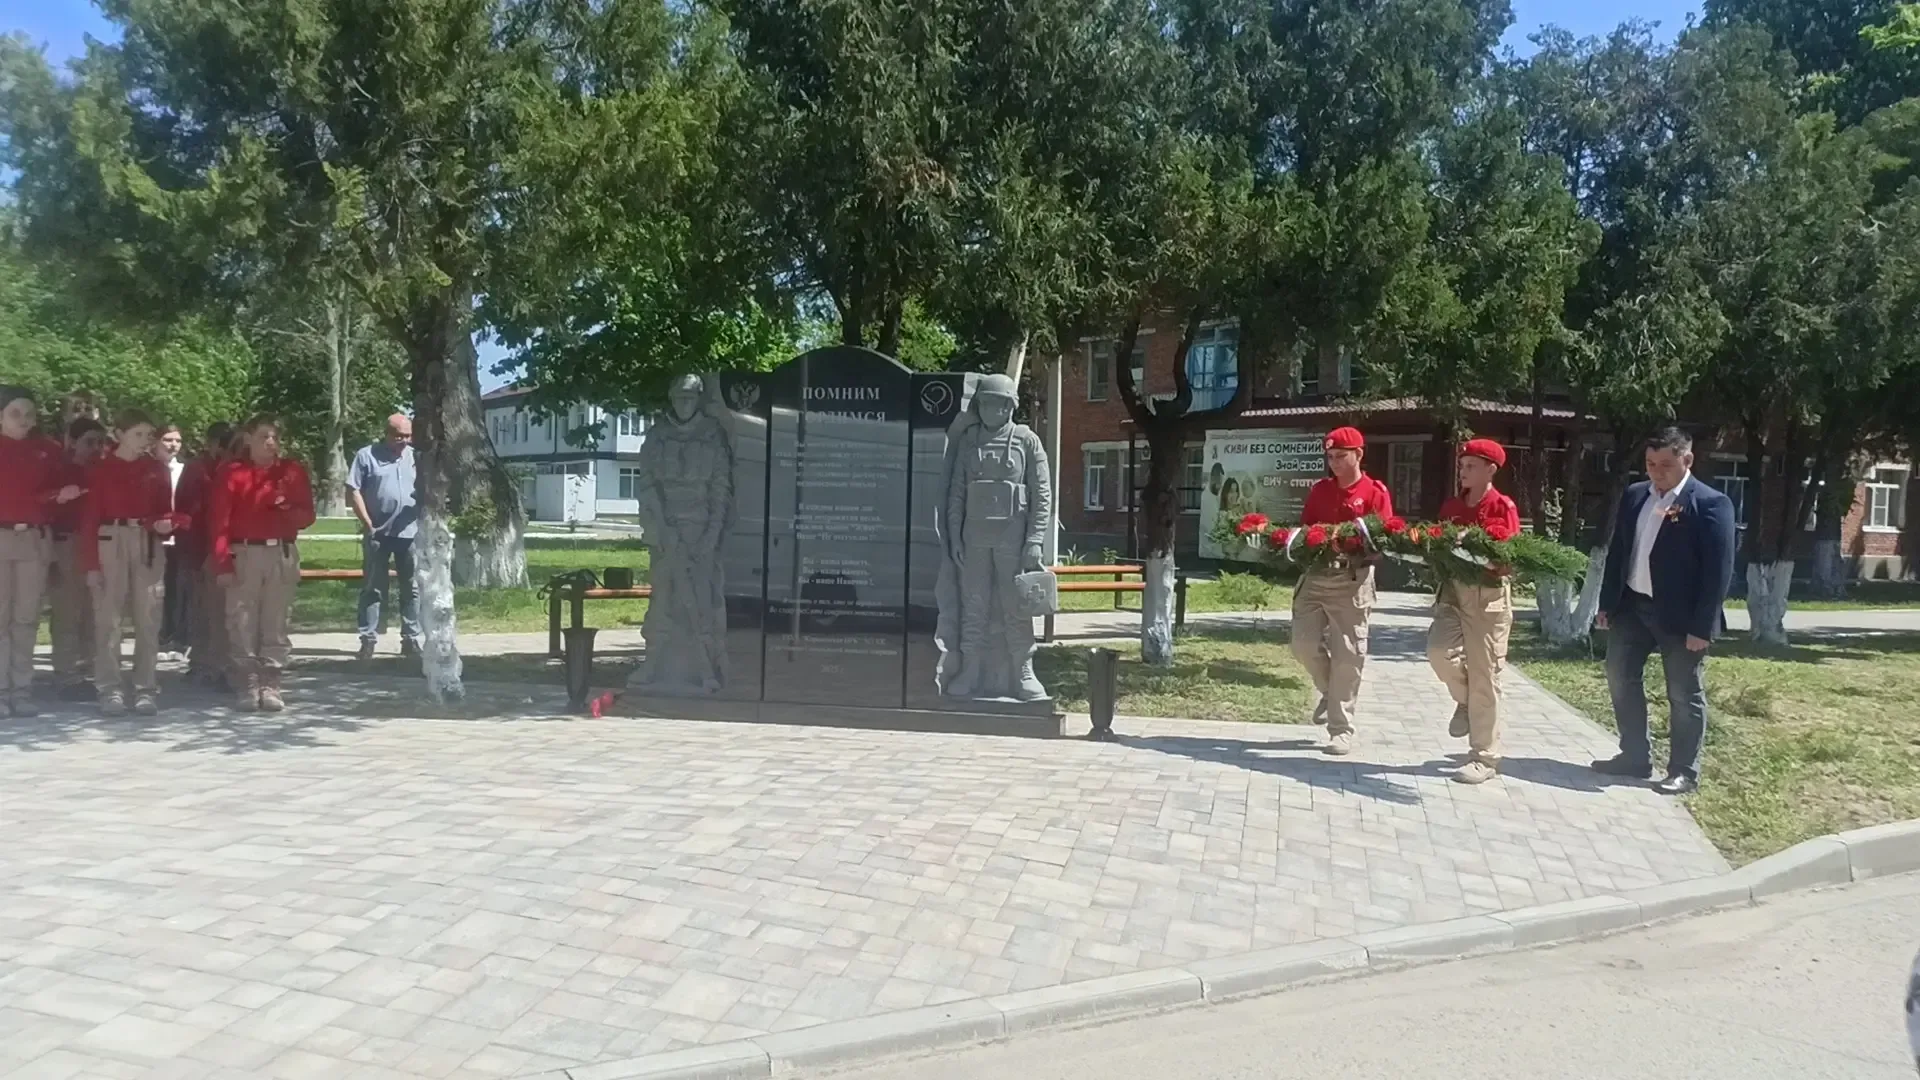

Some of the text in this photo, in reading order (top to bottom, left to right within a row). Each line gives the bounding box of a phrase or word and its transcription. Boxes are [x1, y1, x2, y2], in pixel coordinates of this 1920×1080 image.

[802, 386, 880, 400] ПОМНИМ
[1250, 443, 1266, 454] БЕЗ
[1276, 459, 1324, 470] Знай свой
[1263, 476, 1281, 487] ВИЧ
